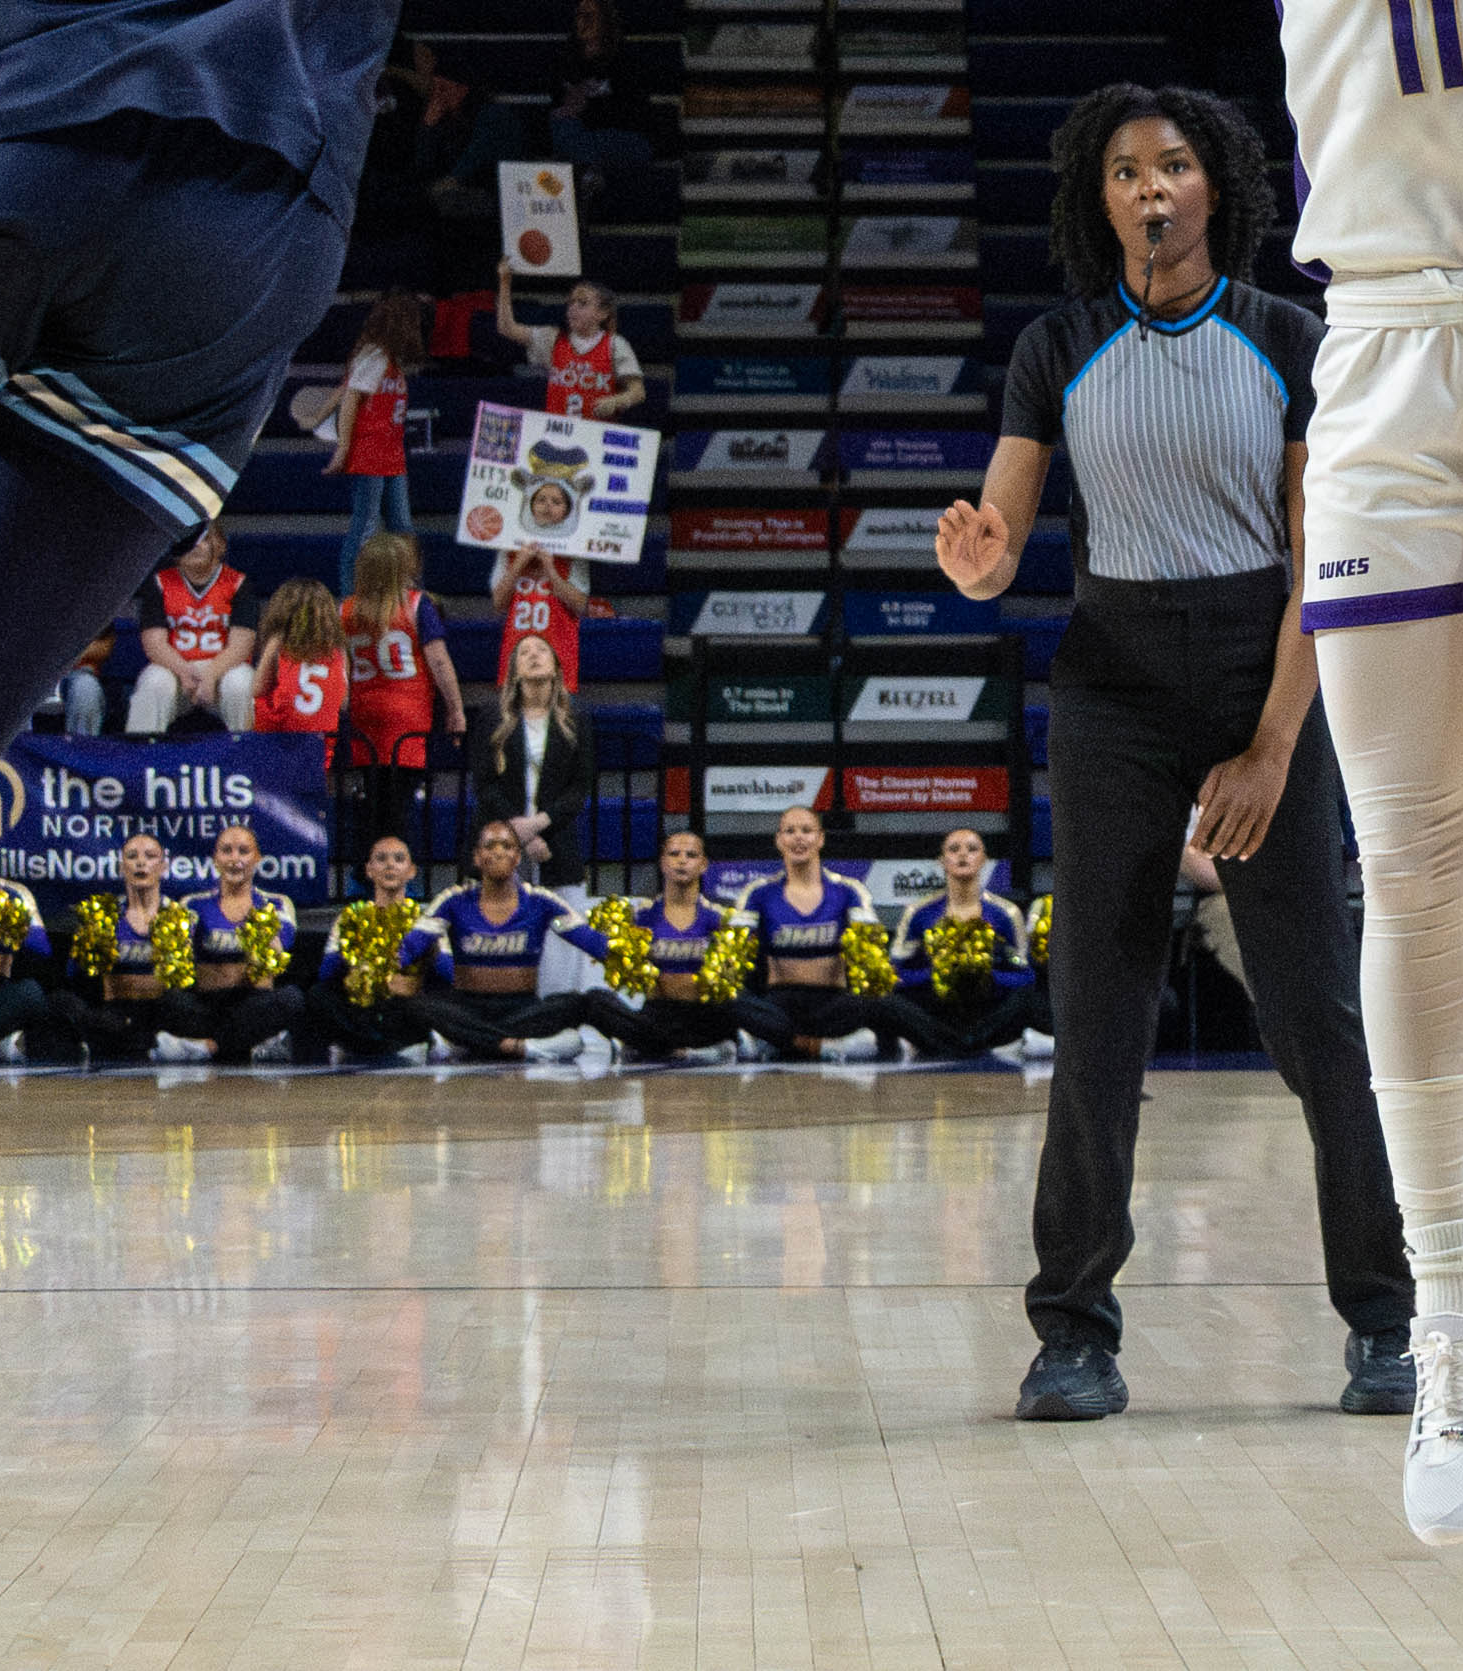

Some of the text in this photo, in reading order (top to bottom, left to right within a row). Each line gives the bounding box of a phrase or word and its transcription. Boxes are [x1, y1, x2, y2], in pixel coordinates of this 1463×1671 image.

[545, 419, 575, 437] JMU
[1319, 557, 1370, 580] DUKES
[513, 600, 551, 632] 20
[293, 663, 329, 715] 5
[41, 765, 253, 809] the hills
[42, 813, 252, 839] NORTHVIEW
[461, 930, 530, 956] JMU
[772, 920, 839, 948] JMU
